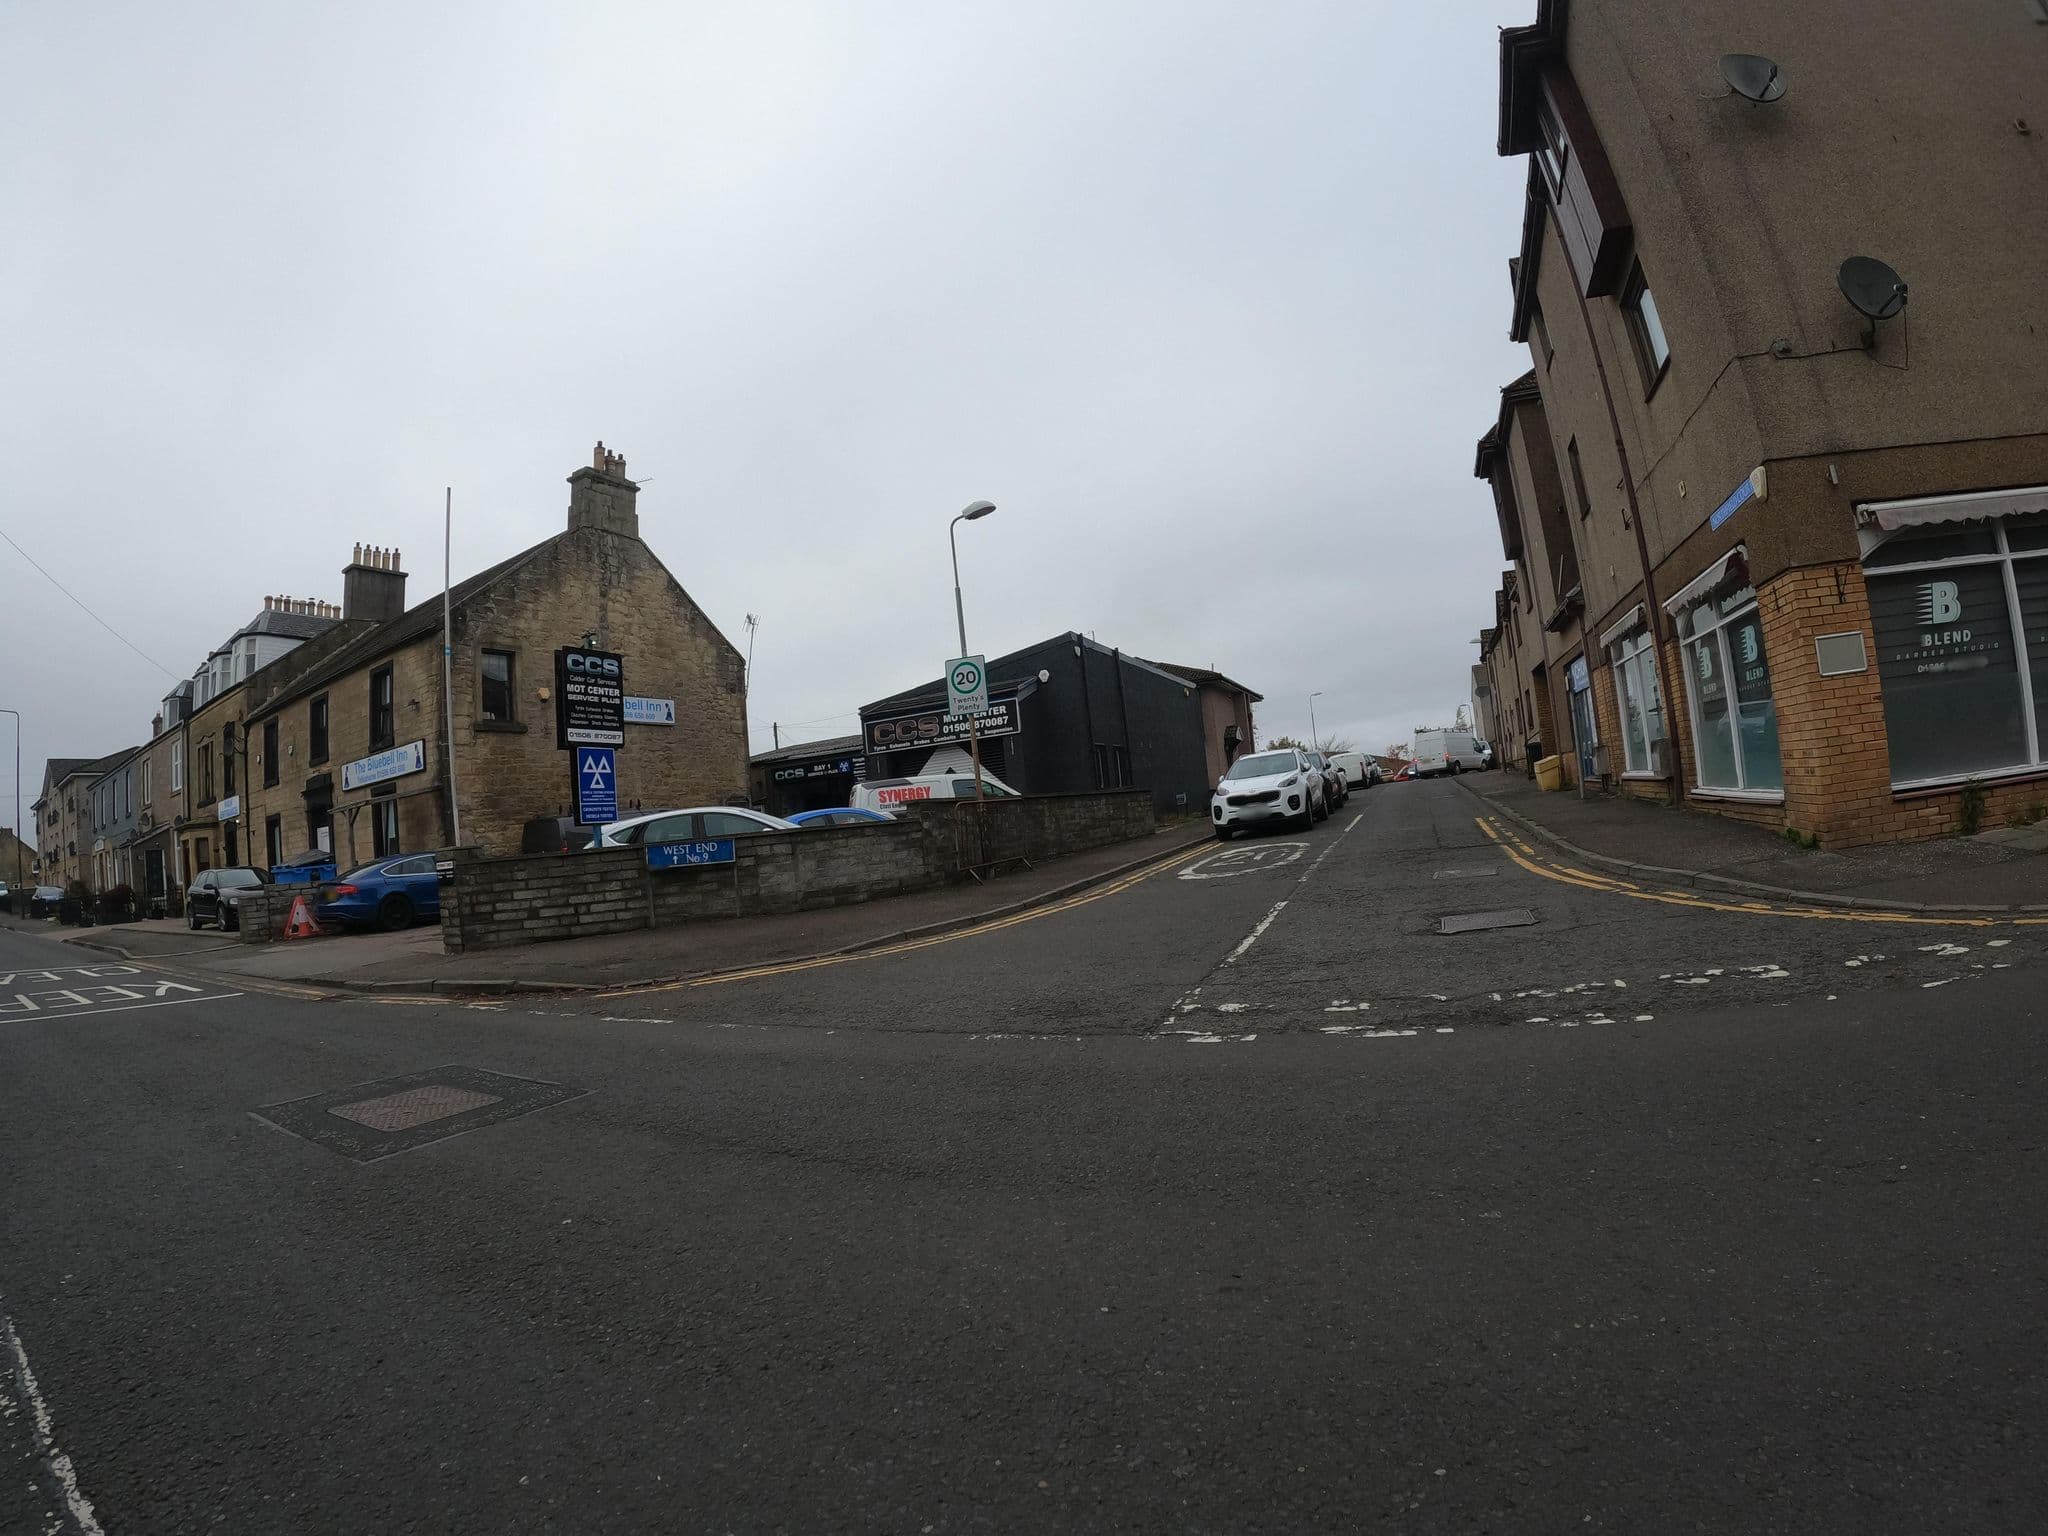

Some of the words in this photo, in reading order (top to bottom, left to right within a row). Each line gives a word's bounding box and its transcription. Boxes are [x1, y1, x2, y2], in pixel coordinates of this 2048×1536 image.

[1923, 630, 1971, 647] BLEND
[1954, 643, 1999, 654] STUDIO
[566, 654, 619, 677] CCS
[956, 671, 976, 685] 20
[566, 684, 586, 694] MOT
[587, 686, 620, 697] CENTER
[567, 694, 600, 703] SERVICE
[646, 700, 661, 711] Inn
[958, 703, 980, 712] Plenty
[874, 716, 940, 744] CCS
[943, 721, 971, 733] 01506
[974, 716, 1009, 729] 870087
[354, 762, 366, 774] The
[367, 750, 395, 772] Bluebell
[396, 750, 408, 763] Inn
[775, 768, 805, 780] CCS
[878, 786, 931, 803] SYNERGY
[663, 844, 691, 855] WEST
[696, 842, 718, 853] END
[686, 854, 700, 863] No
[703, 853, 709, 861] 9
